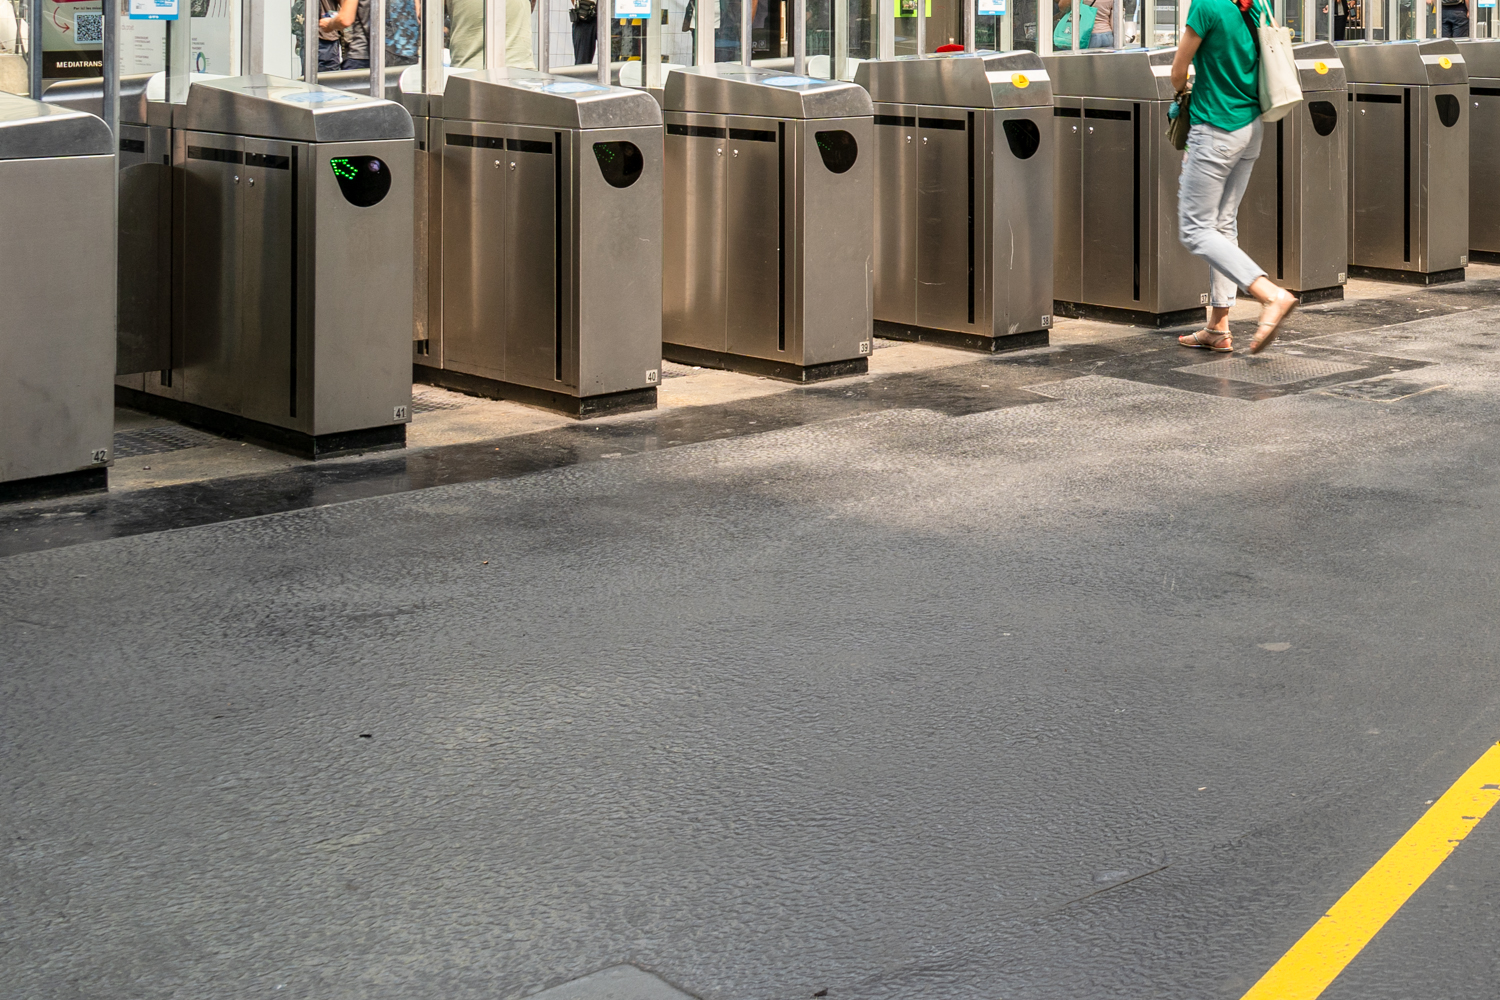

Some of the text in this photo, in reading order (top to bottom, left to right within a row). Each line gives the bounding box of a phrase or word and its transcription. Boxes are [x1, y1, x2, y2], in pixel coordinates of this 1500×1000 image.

[1201, 294, 1207, 303] 37
[1043, 316, 1049, 325] 38
[861, 343, 868, 352] 39
[648, 372, 656, 382] 40
[396, 408, 405, 418] 41
[94, 450, 106, 462] 42
